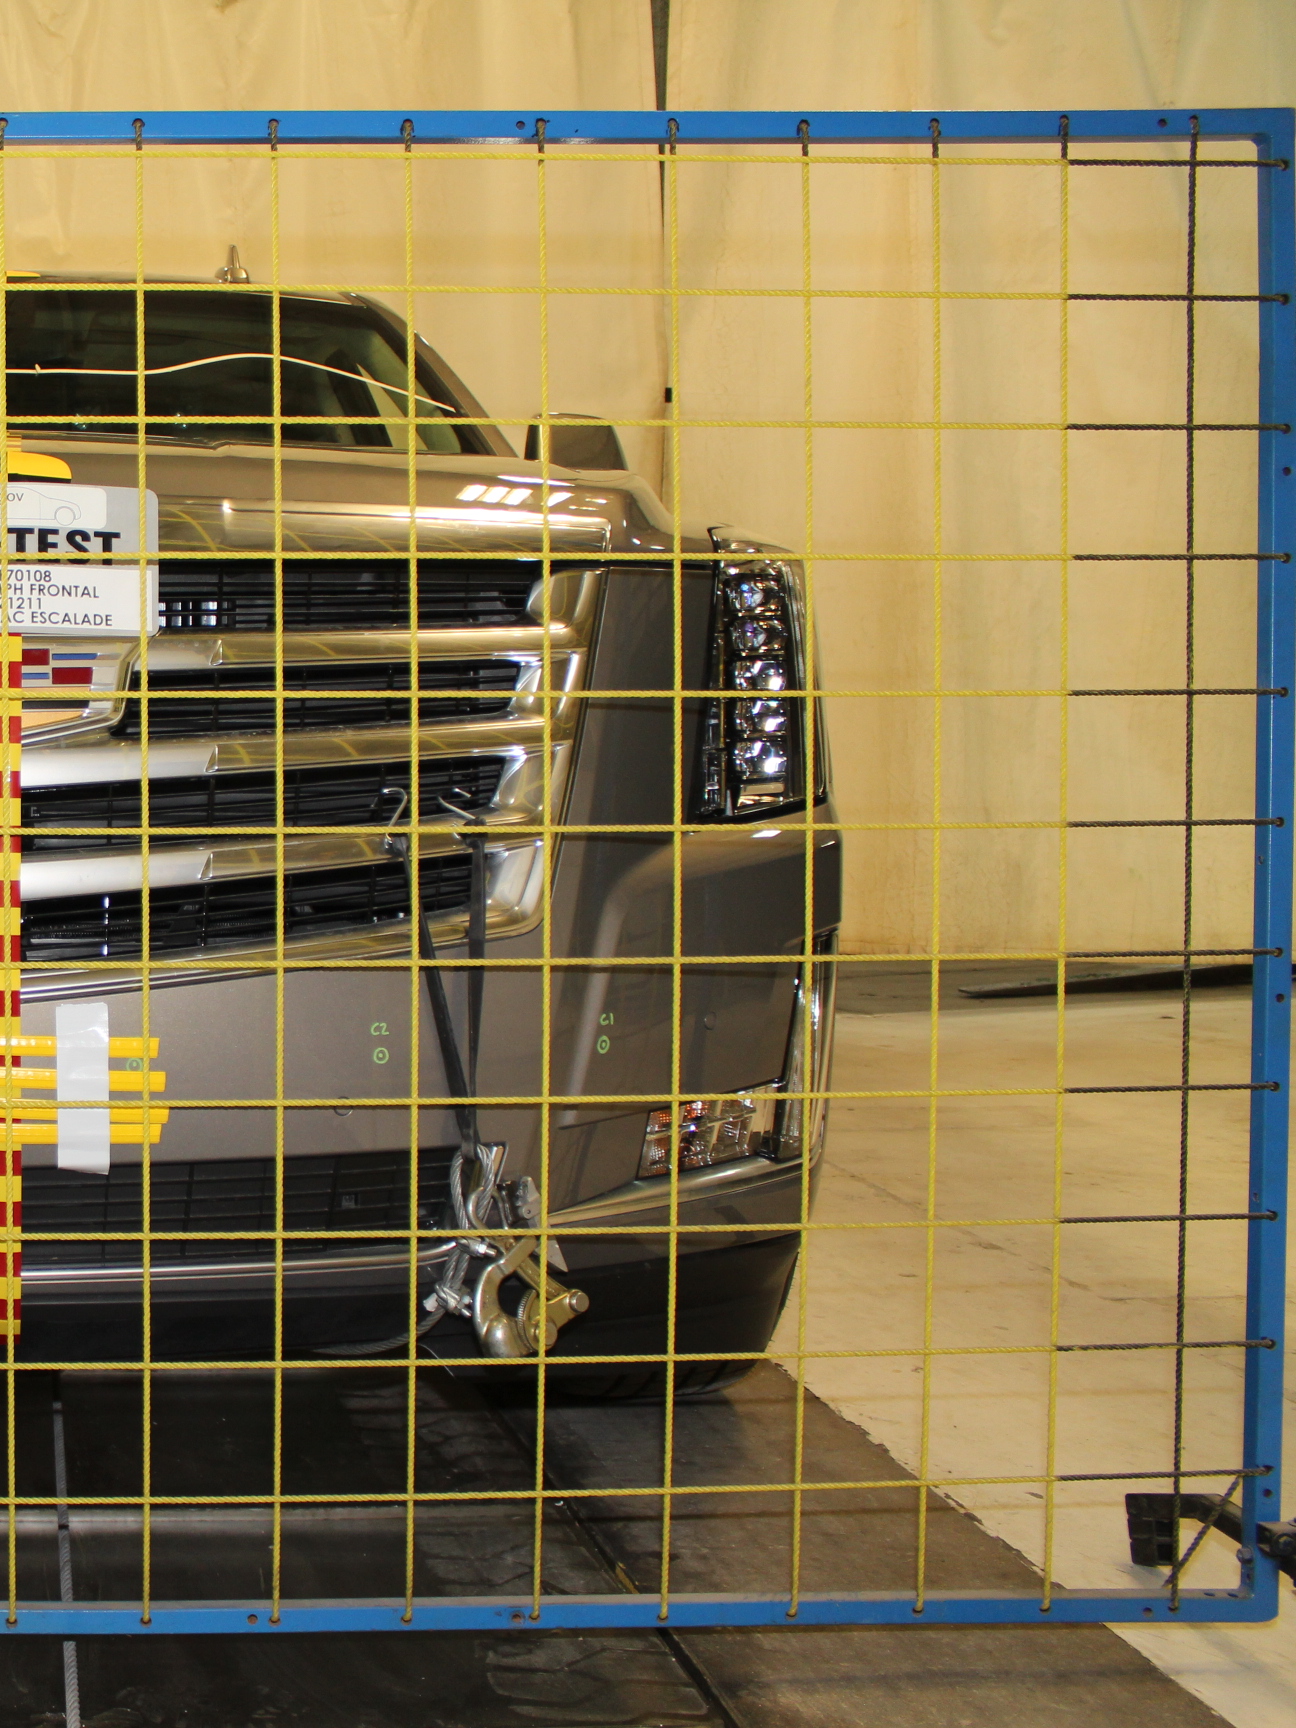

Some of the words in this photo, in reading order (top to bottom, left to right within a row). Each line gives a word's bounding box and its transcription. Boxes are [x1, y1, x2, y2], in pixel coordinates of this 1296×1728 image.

[30, 583, 100, 598] FRONTAL
[31, 611, 113, 626] ESCALADE
[599, 1012, 615, 1026] C1
[370, 1022, 390, 1036] C2
